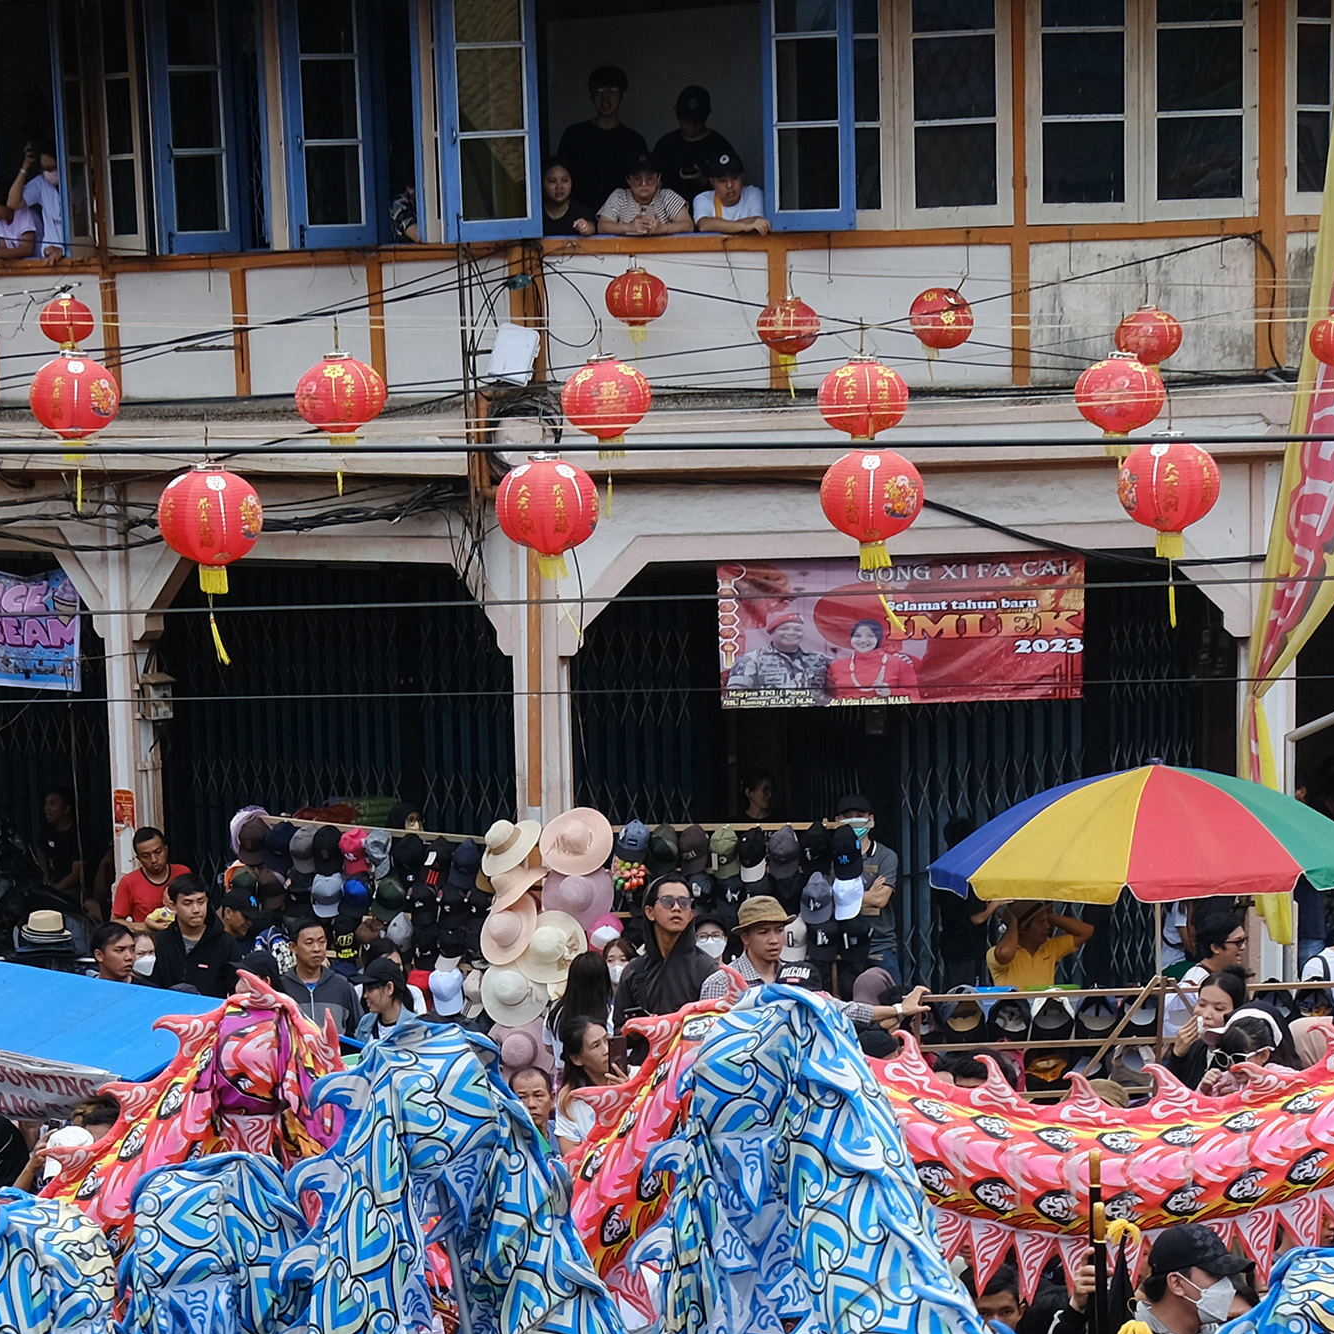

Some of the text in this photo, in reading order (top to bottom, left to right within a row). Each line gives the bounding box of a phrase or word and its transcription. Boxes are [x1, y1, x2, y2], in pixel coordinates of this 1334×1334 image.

[858, 560, 1071, 583] GONG XI FA CAI
[887, 597, 1039, 613] Selamat tahun baru
[884, 610, 1085, 641] IMLEK
[1014, 637, 1085, 655] 2023
